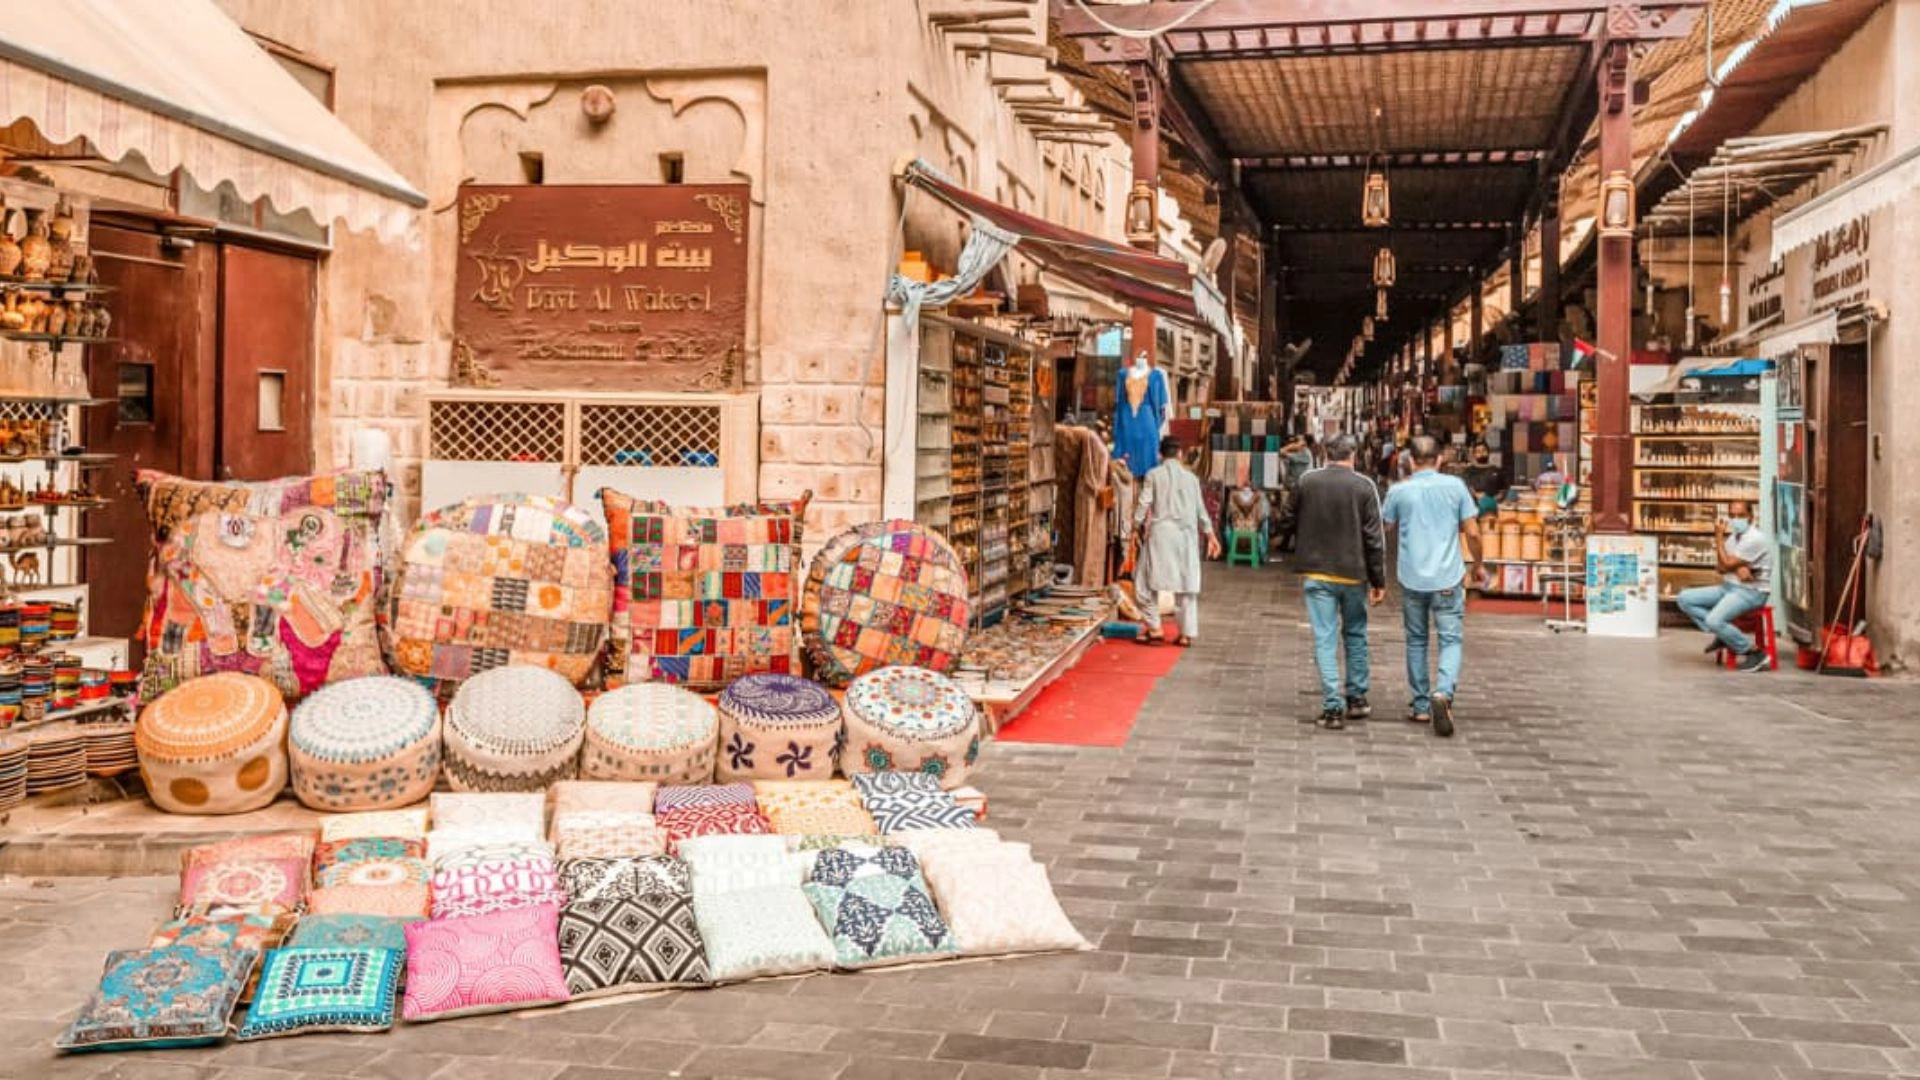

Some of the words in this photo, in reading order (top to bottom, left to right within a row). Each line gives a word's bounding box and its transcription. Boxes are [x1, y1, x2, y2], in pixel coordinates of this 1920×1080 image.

[526, 239, 648, 273] الوكيل
[656, 241, 712, 272] بيت
[590, 286, 613, 311] Al
[622, 284, 712, 312] Wakeel
